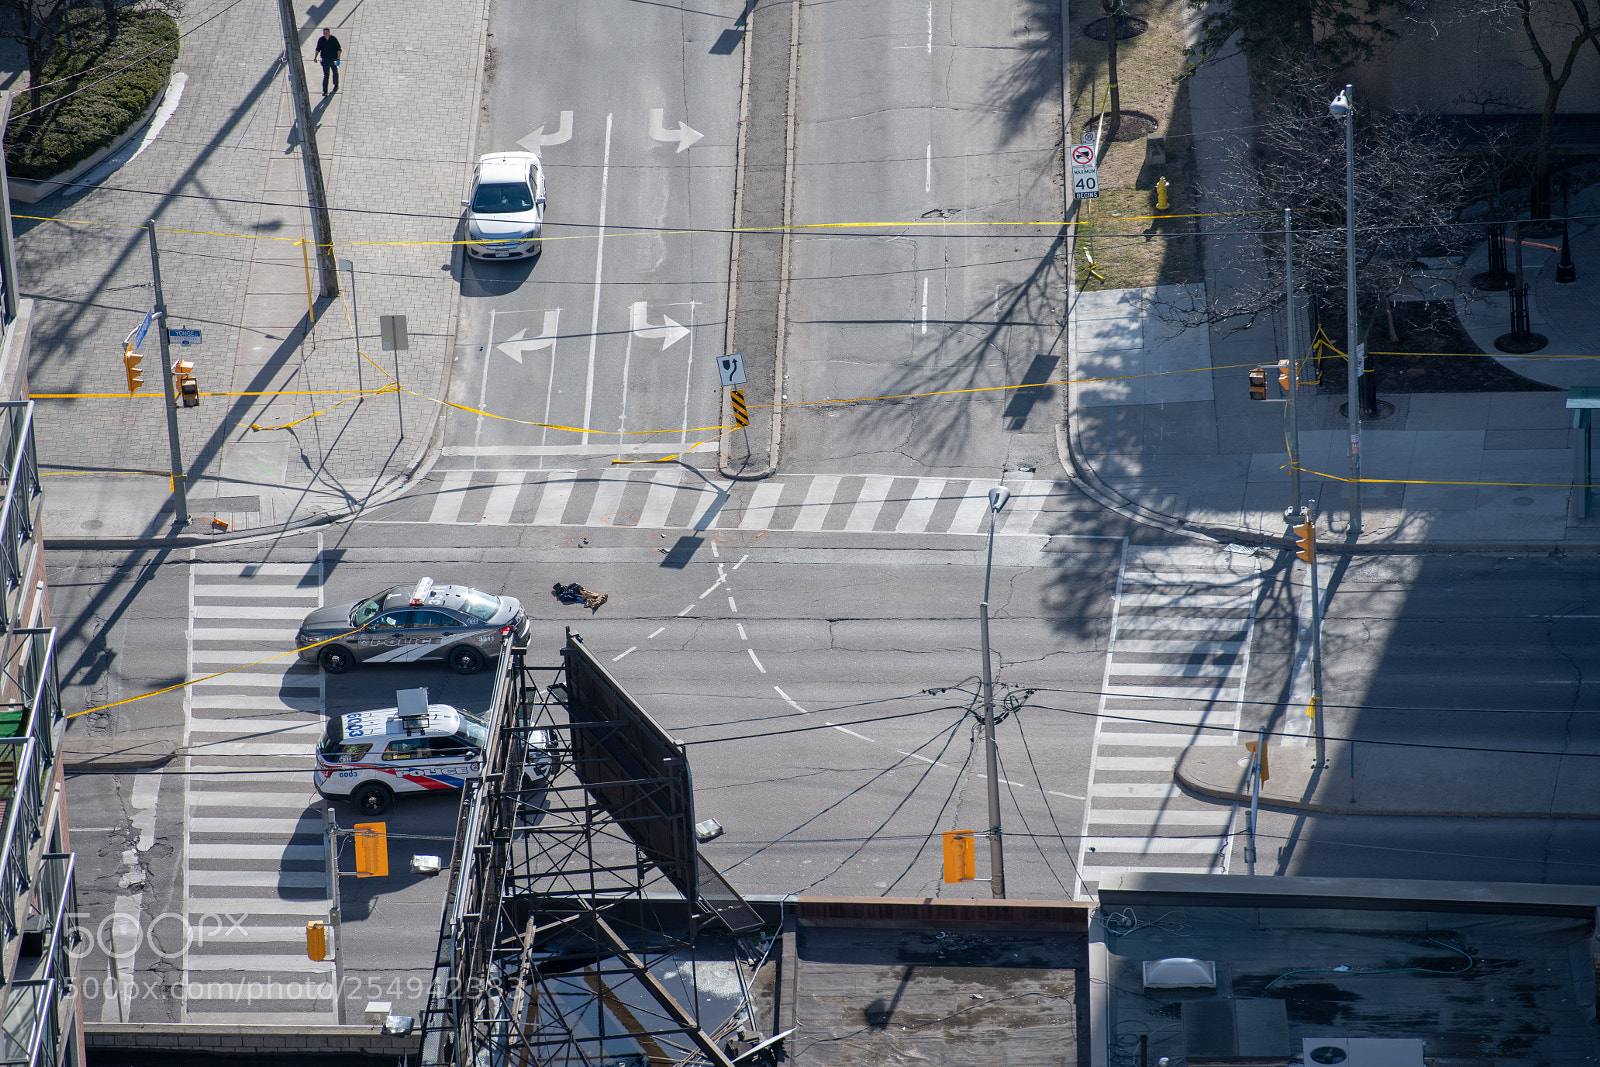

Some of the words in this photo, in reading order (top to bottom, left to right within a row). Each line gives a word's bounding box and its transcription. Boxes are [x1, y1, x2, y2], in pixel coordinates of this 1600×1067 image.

[1075, 177, 1096, 190] 40
[1076, 191, 1098, 199] BEGINS
[370, 637, 443, 647] POLICE
[346, 713, 365, 738] 6003
[395, 766, 469, 779] POLICE
